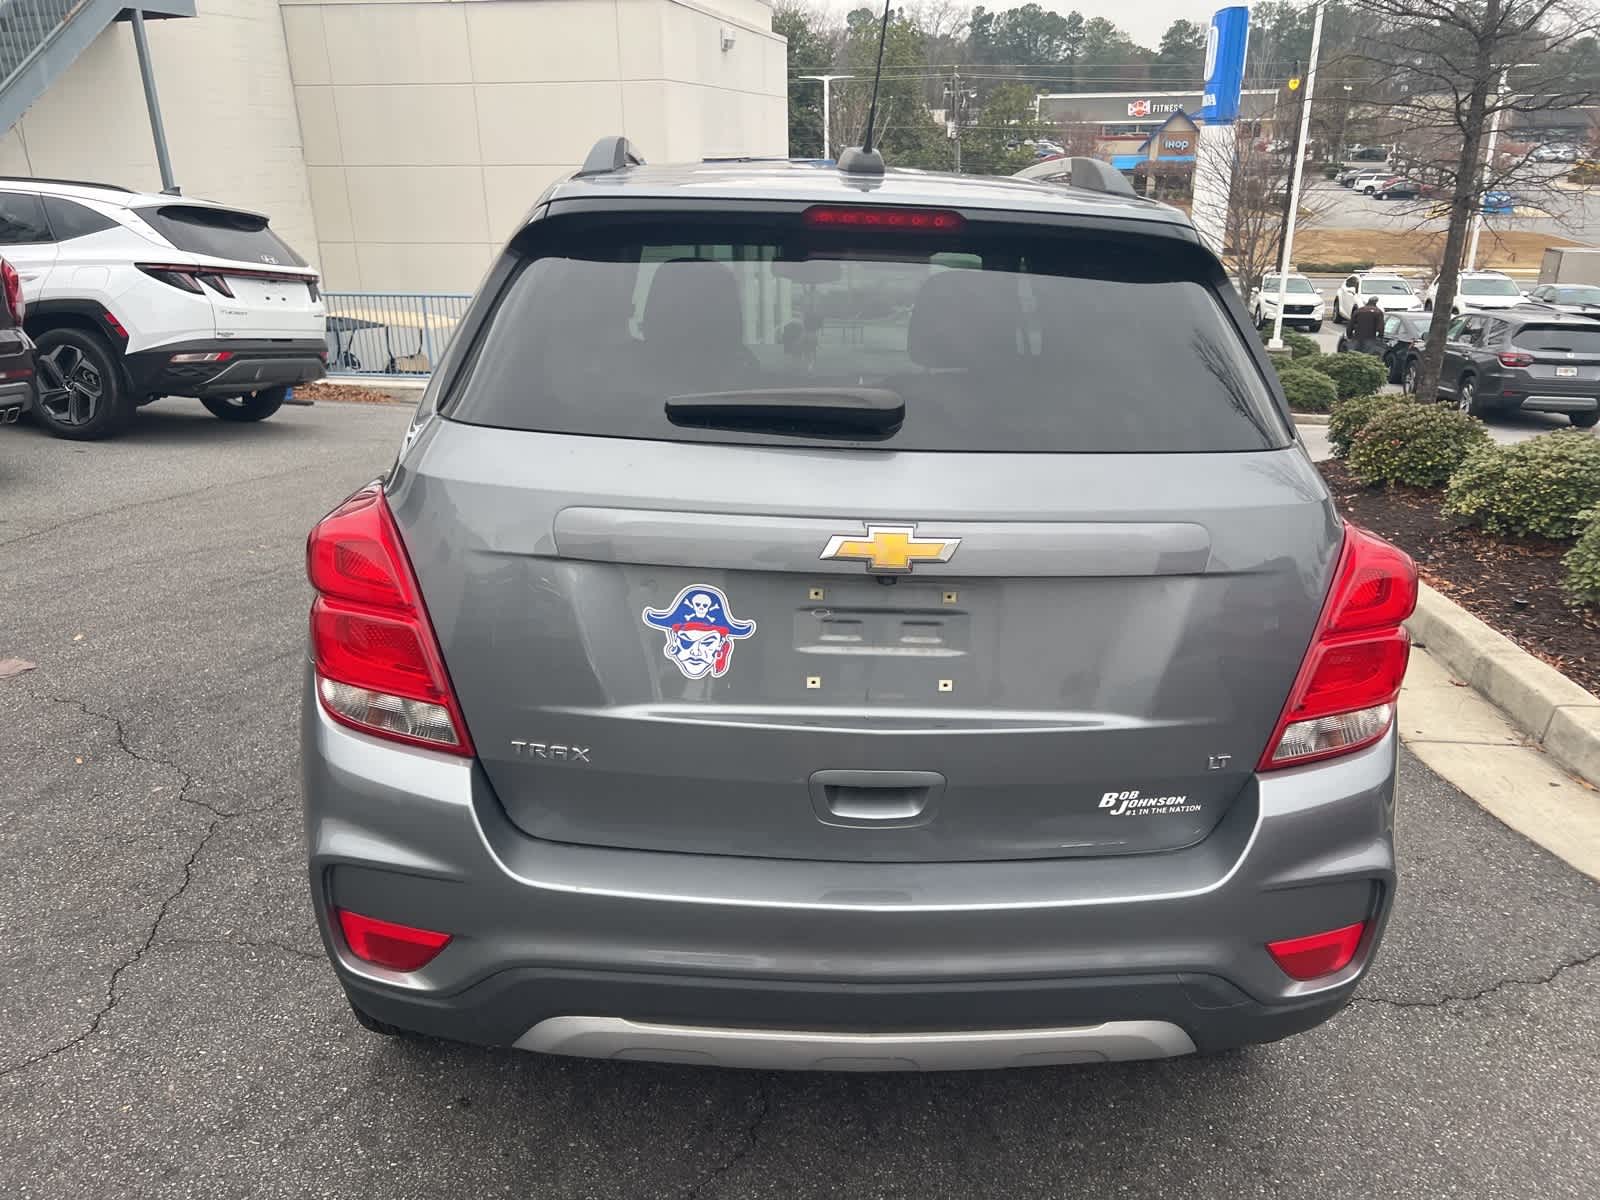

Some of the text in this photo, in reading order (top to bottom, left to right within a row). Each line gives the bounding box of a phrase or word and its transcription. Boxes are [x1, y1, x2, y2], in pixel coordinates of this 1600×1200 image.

[1152, 103, 1184, 113] FITNESS
[510, 740, 590, 762] TRAX
[1209, 755, 1232, 769] LT
[1138, 808, 1149, 816] IN
[1151, 807, 1167, 815] THE
[1168, 804, 1202, 813] NATION
